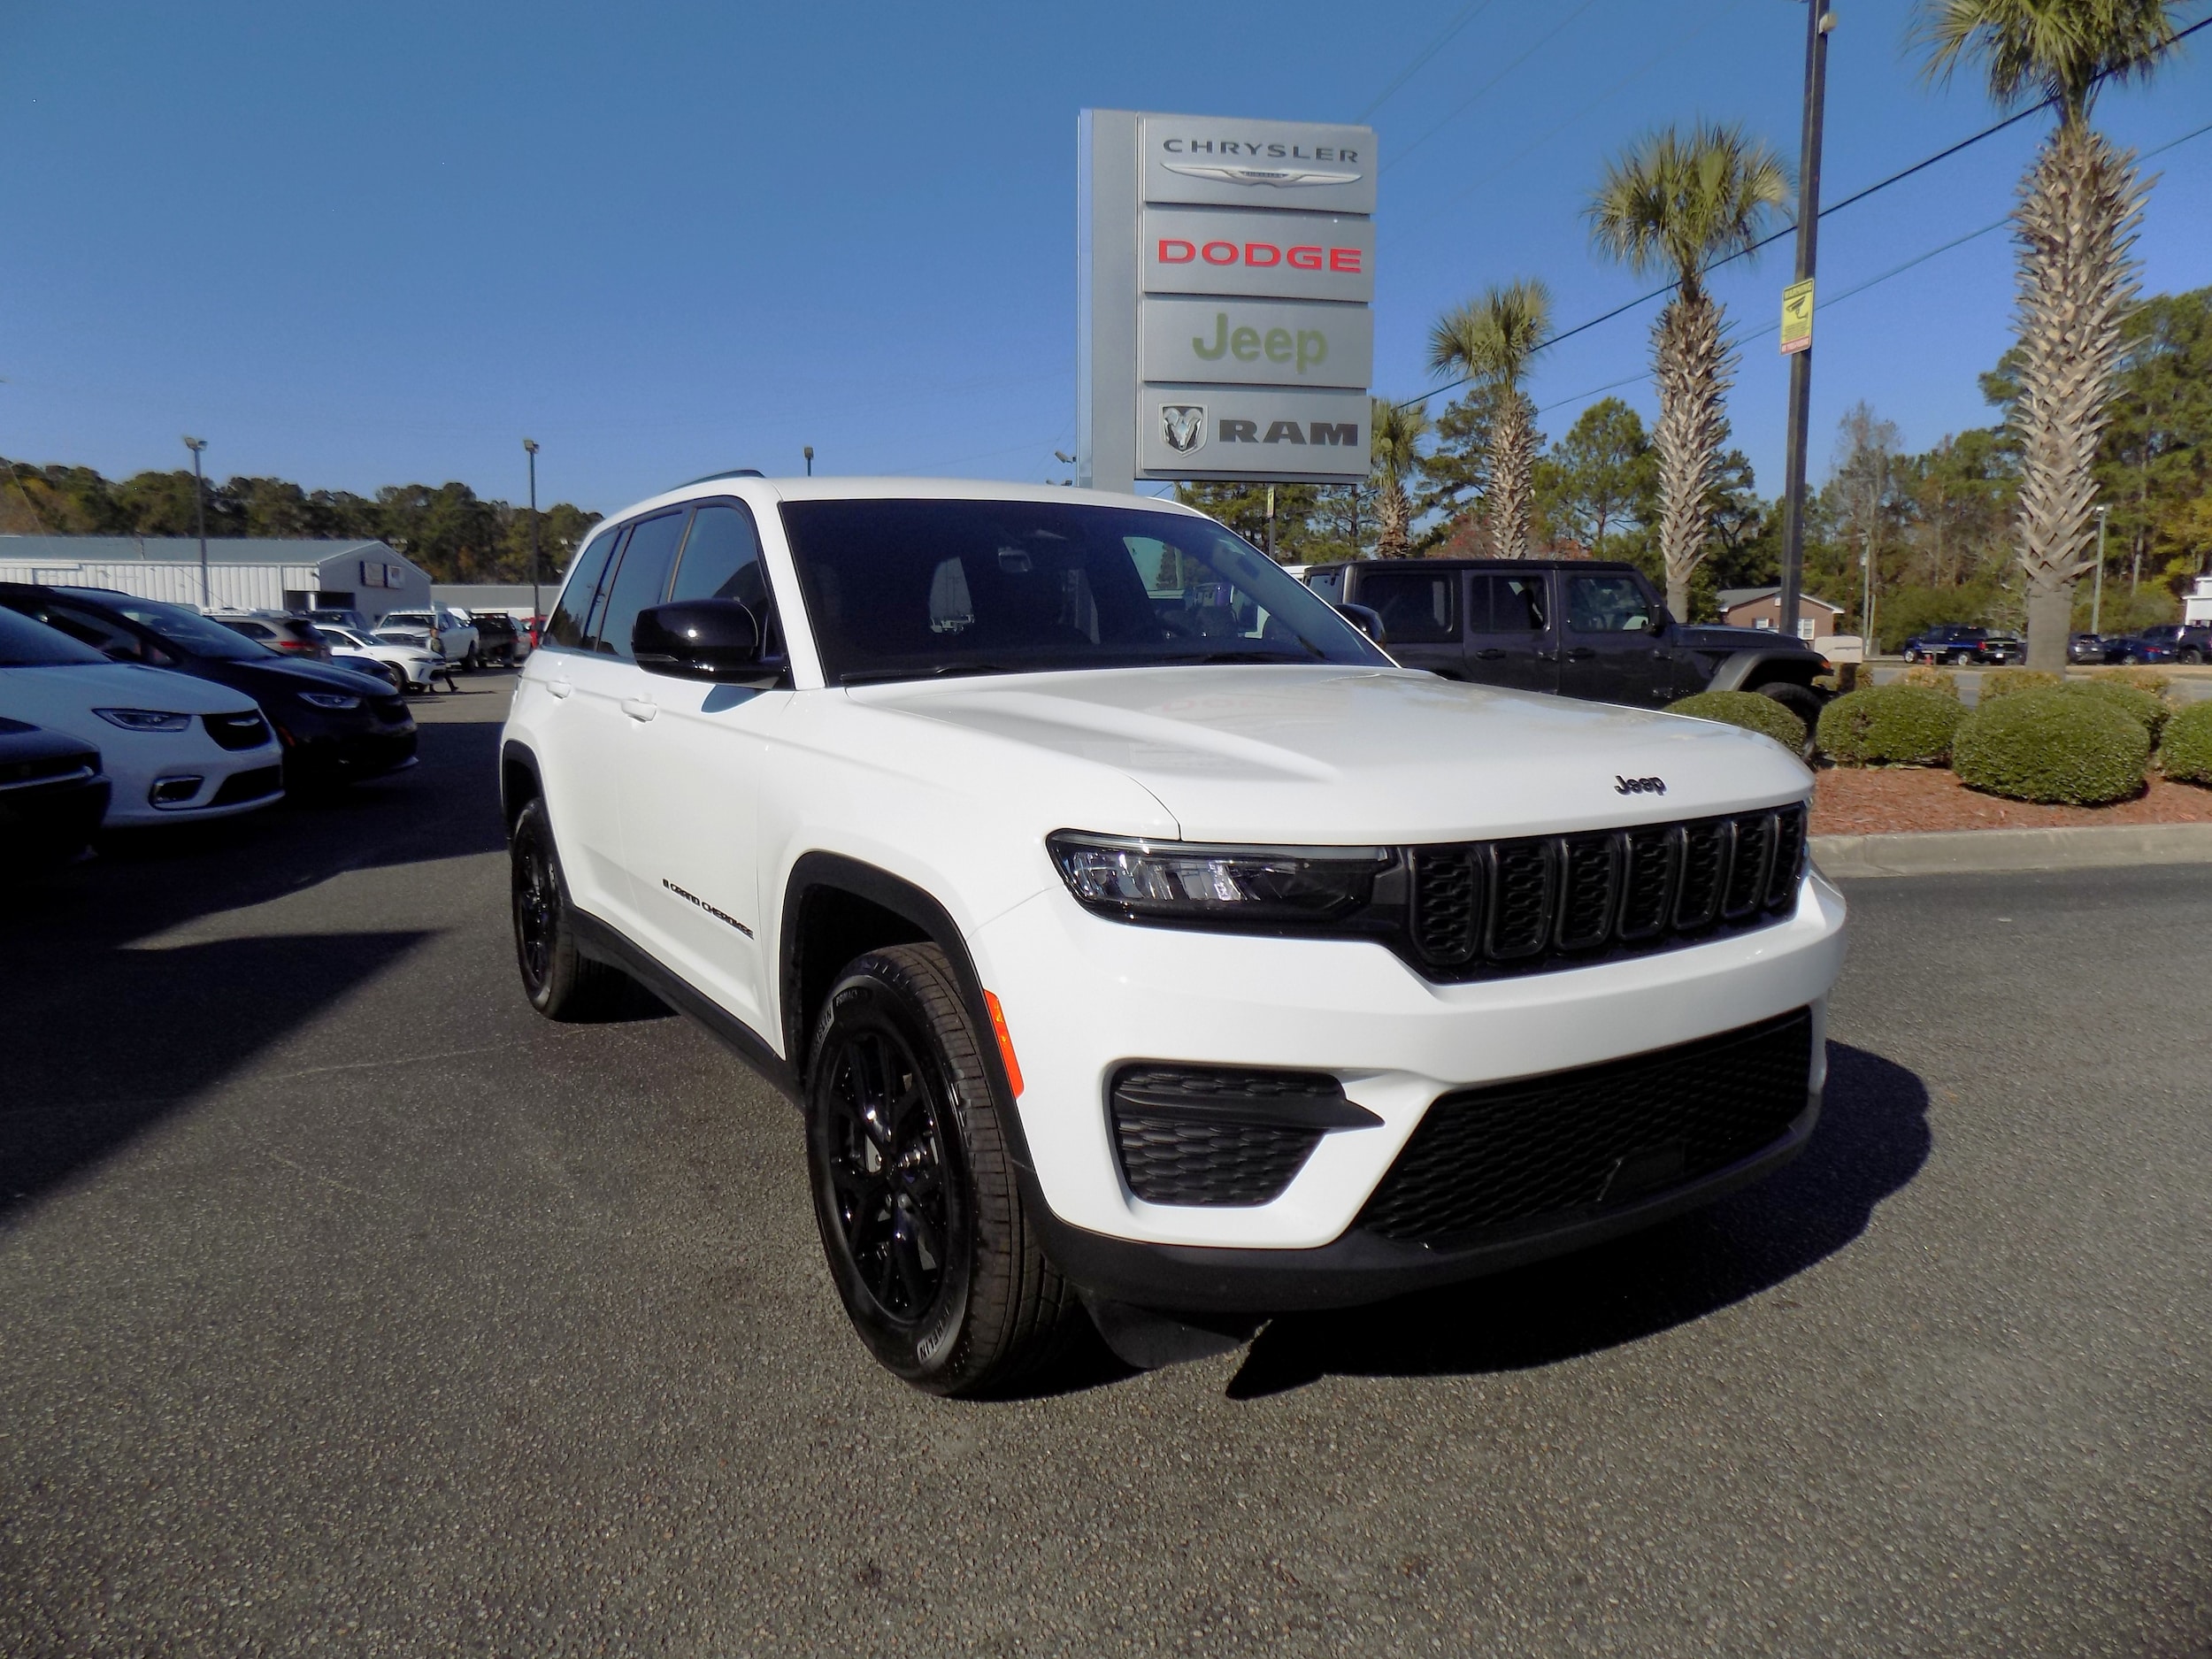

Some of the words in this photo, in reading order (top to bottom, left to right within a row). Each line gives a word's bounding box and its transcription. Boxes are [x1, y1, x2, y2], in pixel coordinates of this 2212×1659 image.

[1163, 138, 1359, 164] CHRYSLER
[1158, 240, 1363, 274] DODGE
[1192, 312, 1327, 373] Jeep
[1219, 419, 1359, 448] RAM
[1614, 775, 1667, 796] Jeep
